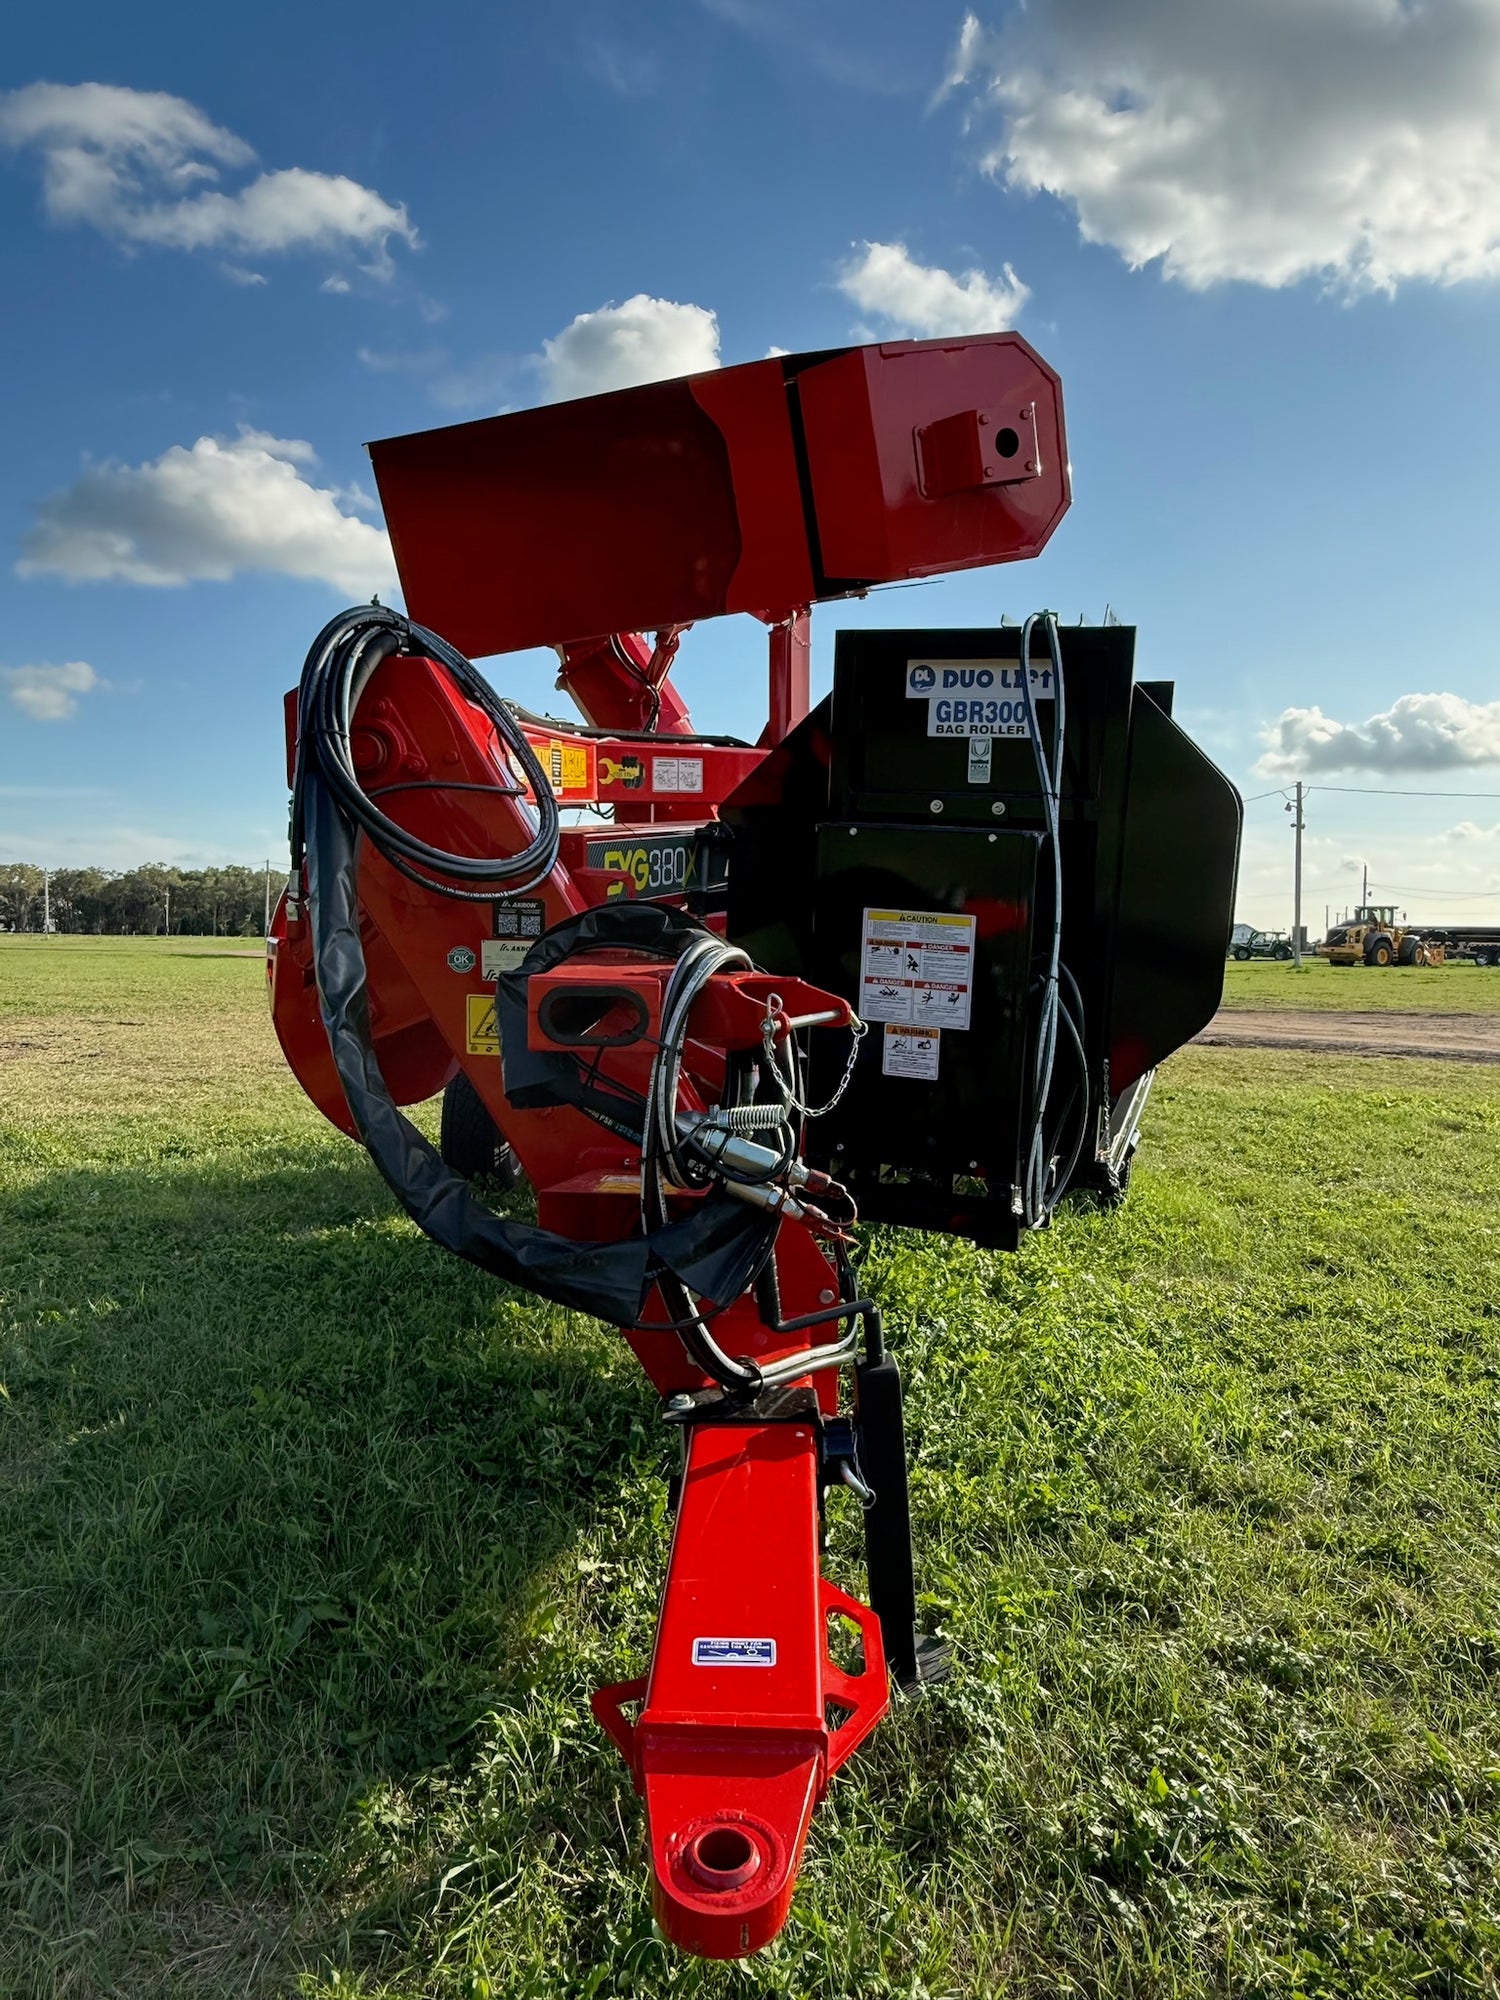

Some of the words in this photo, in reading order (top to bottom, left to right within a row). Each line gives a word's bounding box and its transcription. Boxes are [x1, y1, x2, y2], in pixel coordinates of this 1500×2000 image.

[943, 669, 994, 688] DUO
[936, 700, 1027, 723] GBR300
[936, 724, 964, 735] BAG
[969, 724, 1025, 735] ROLLER
[906, 914, 938, 924] CAUTION
[928, 943, 954, 951] DANGER
[453, 954, 469, 964] OK
[879, 978, 905, 986] DANGER
[931, 983, 959, 991] DANGER
